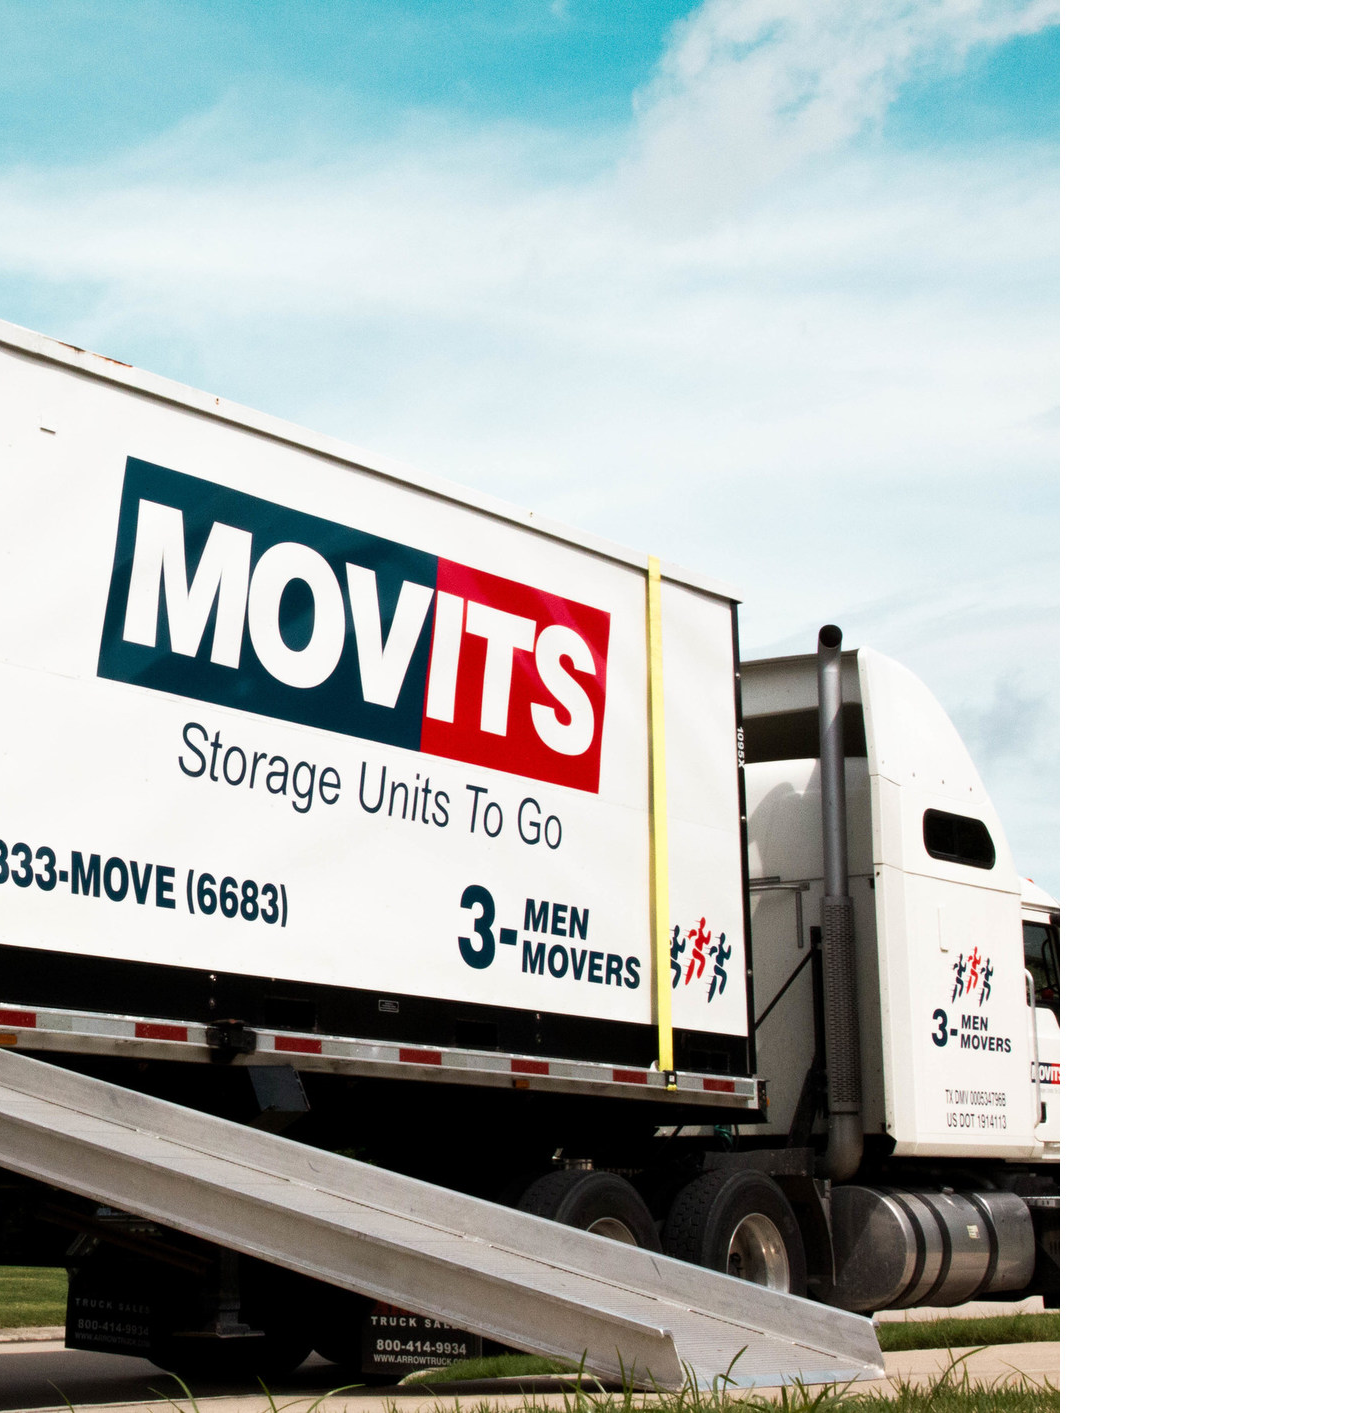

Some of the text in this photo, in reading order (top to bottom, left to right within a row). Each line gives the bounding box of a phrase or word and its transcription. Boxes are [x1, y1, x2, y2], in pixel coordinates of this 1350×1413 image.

[122, 497, 597, 756] MOVITS
[737, 726, 745, 768] 1095X
[178, 721, 563, 850] Storage Units To Go
[186, 868, 288, 927] (6683)
[457, 885, 590, 970] 3- MEN
[521, 940, 642, 990] MOVERS
[931, 1008, 989, 1047] 3- MEN
[960, 1034, 1012, 1053] MOVERS
[945, 1089, 954, 1104] TX
[954, 1089, 969, 1105] DMV
[946, 1112, 1007, 1130] US DOT 1914113
[75, 1297, 113, 1309] TRUCK
[370, 1316, 456, 1330] TRUCK SAL
[376, 1339, 467, 1356] 800-414-9934
